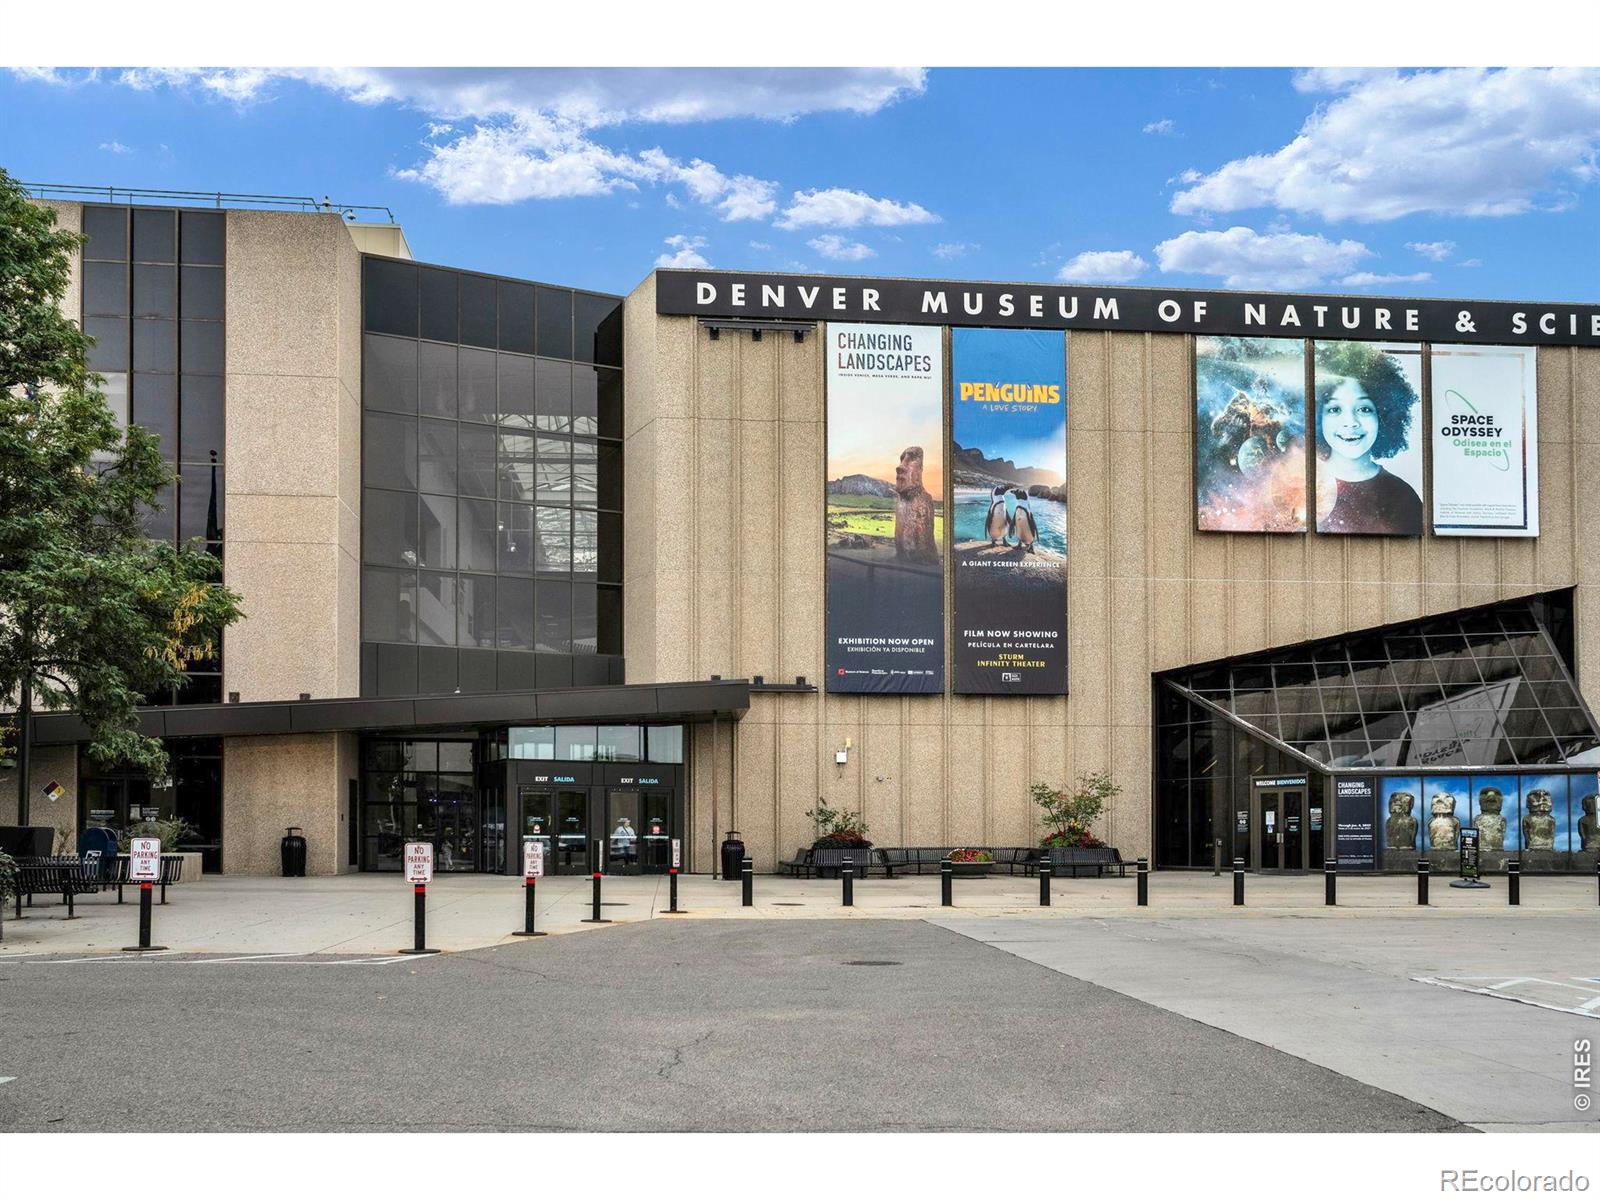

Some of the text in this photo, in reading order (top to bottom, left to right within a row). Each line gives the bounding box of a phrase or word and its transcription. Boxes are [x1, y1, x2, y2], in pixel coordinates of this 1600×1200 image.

[696, 282, 1600, 336] DENVER MUSEUM OF NATURE & SCIE
[838, 332, 912, 352] CHANGING
[838, 352, 932, 372] LANDSCAPES
[1011, 404, 1038, 412] STORY
[1451, 415, 1493, 425] SPACE
[1441, 427, 1502, 437] ODYSSEY
[1464, 448, 1502, 458] Espacio
[134, 851, 158, 859] PARKING
